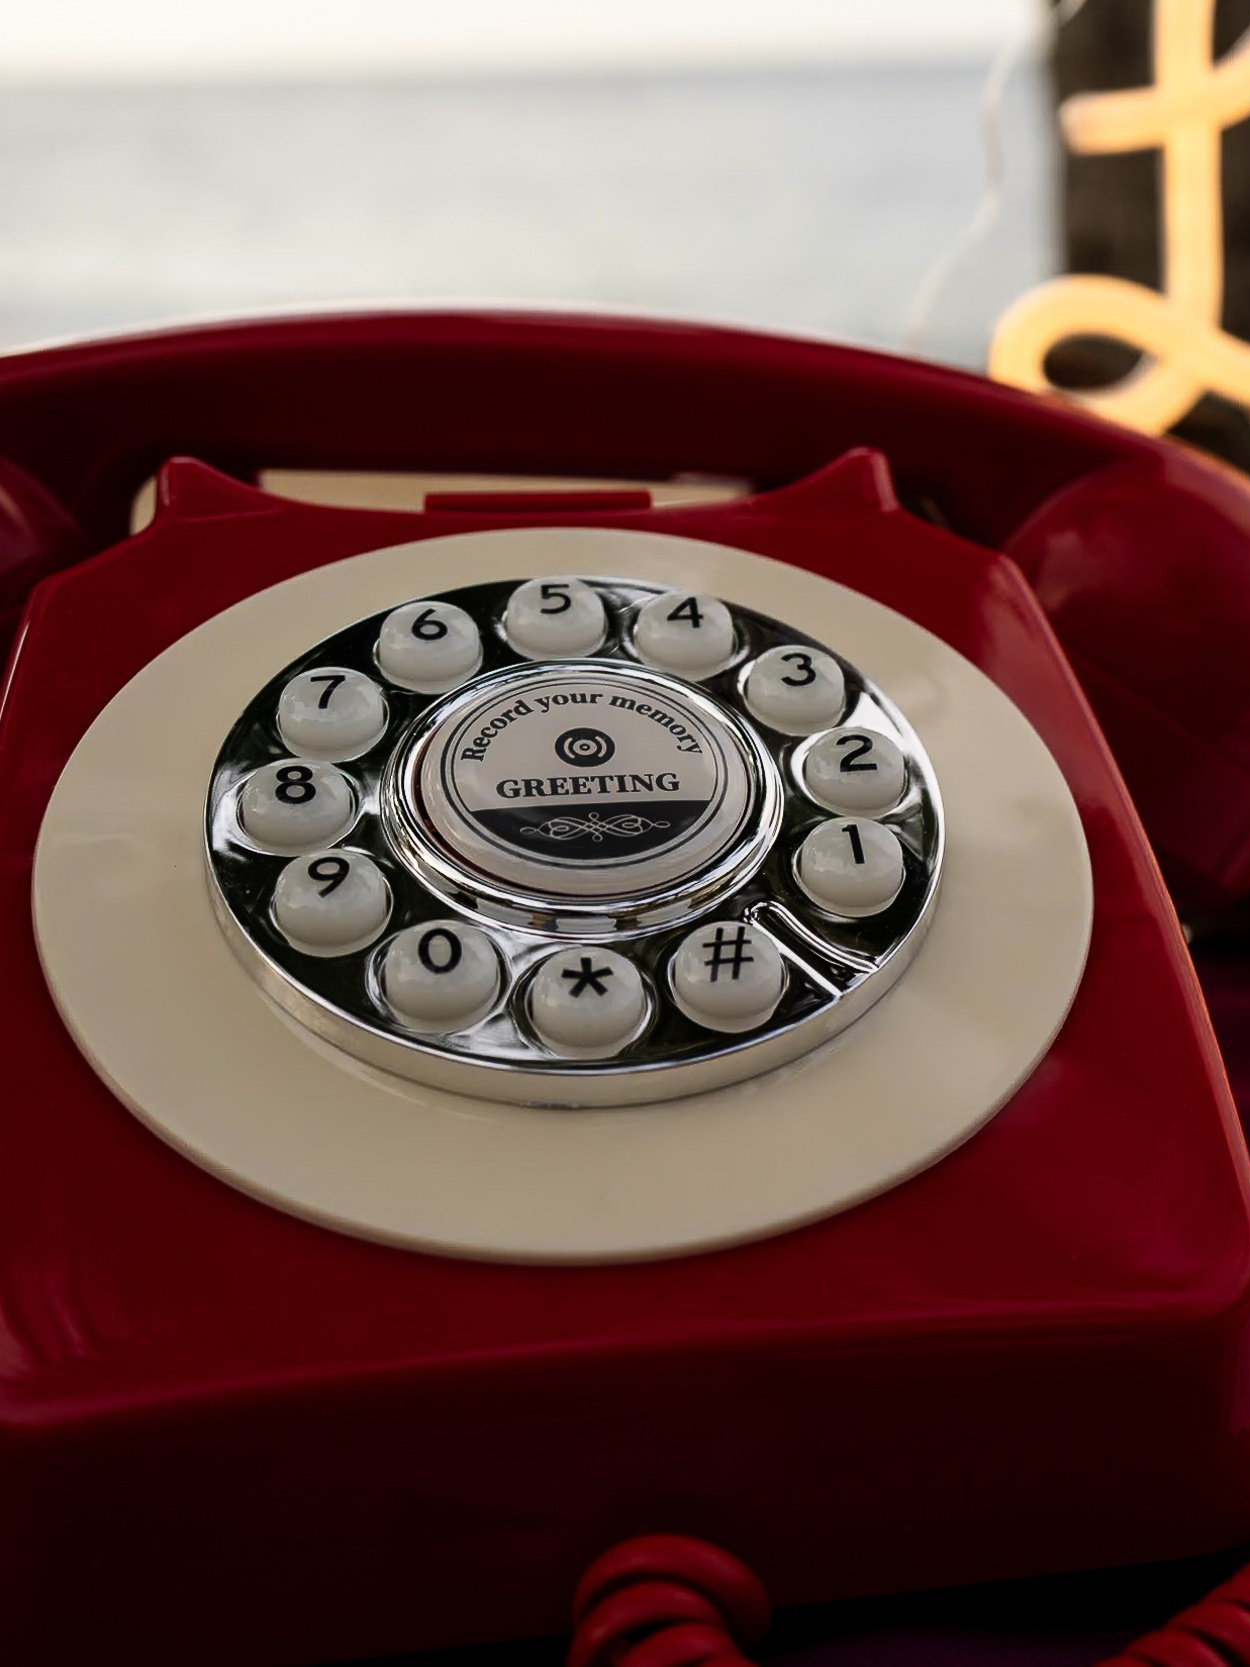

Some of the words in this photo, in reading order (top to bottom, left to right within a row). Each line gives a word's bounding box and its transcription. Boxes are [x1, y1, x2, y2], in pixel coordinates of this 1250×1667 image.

[540, 583, 572, 615] 5
[666, 596, 704, 629] 4
[411, 608, 449, 642] 6
[780, 652, 817, 687] 3
[309, 674, 346, 710] 7
[461, 699, 534, 763] Record
[541, 691, 604, 713] your
[608, 694, 703, 754] memory
[835, 734, 878, 773] 2
[274, 765, 317, 806] 8
[495, 772, 680, 799] GREETING
[841, 823, 866, 865] 1
[307, 856, 351, 899] 9
[417, 927, 463, 975] 0
[701, 925, 755, 984] #
